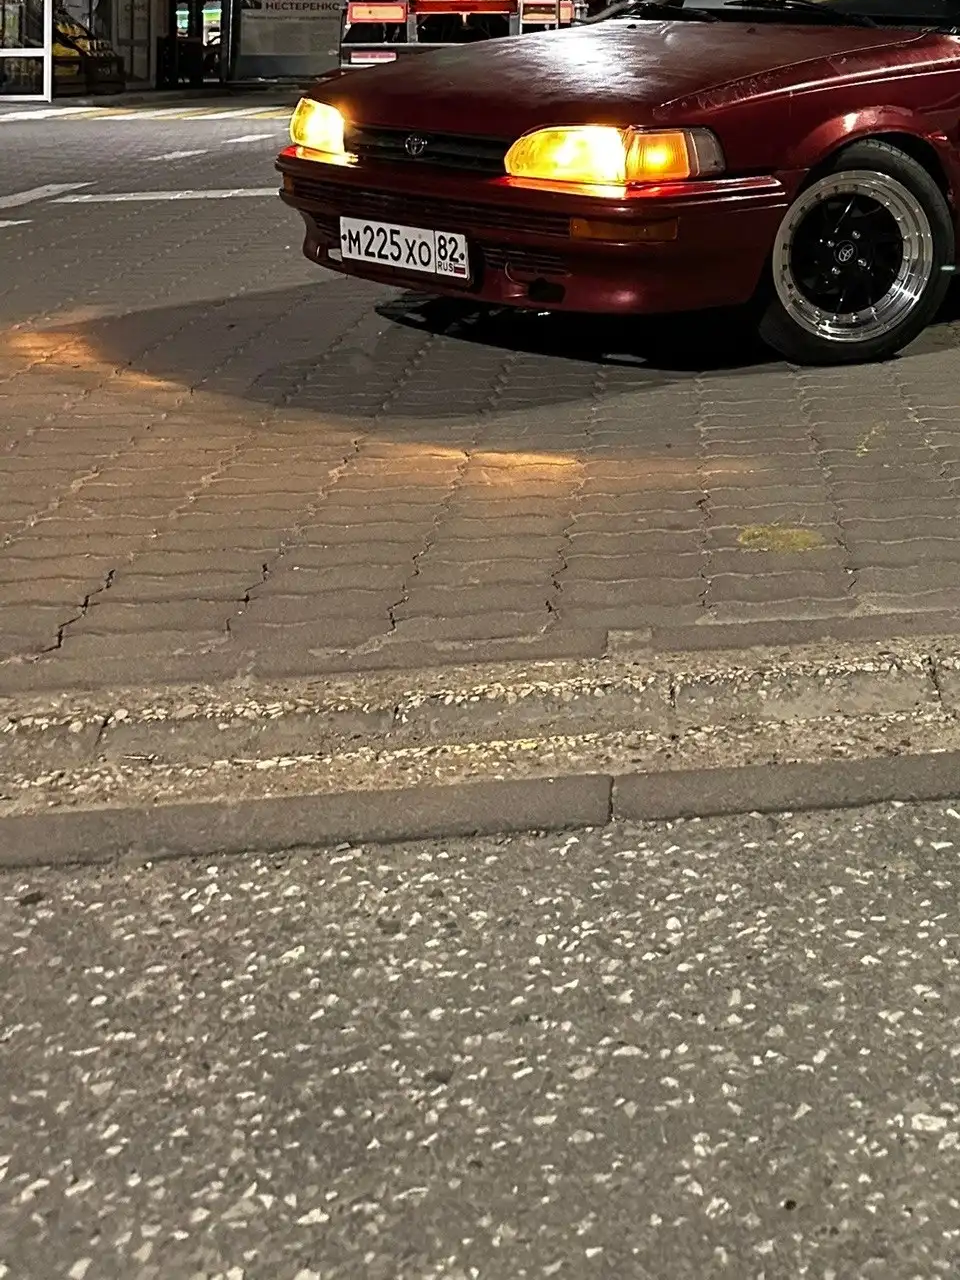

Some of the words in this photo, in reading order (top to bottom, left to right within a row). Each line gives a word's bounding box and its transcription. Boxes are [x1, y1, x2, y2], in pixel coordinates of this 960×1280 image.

[265, 2, 340, 11] НЕСТЕРЕНКО
[437, 235, 459, 263] 82
[437, 261, 454, 272] RUS
